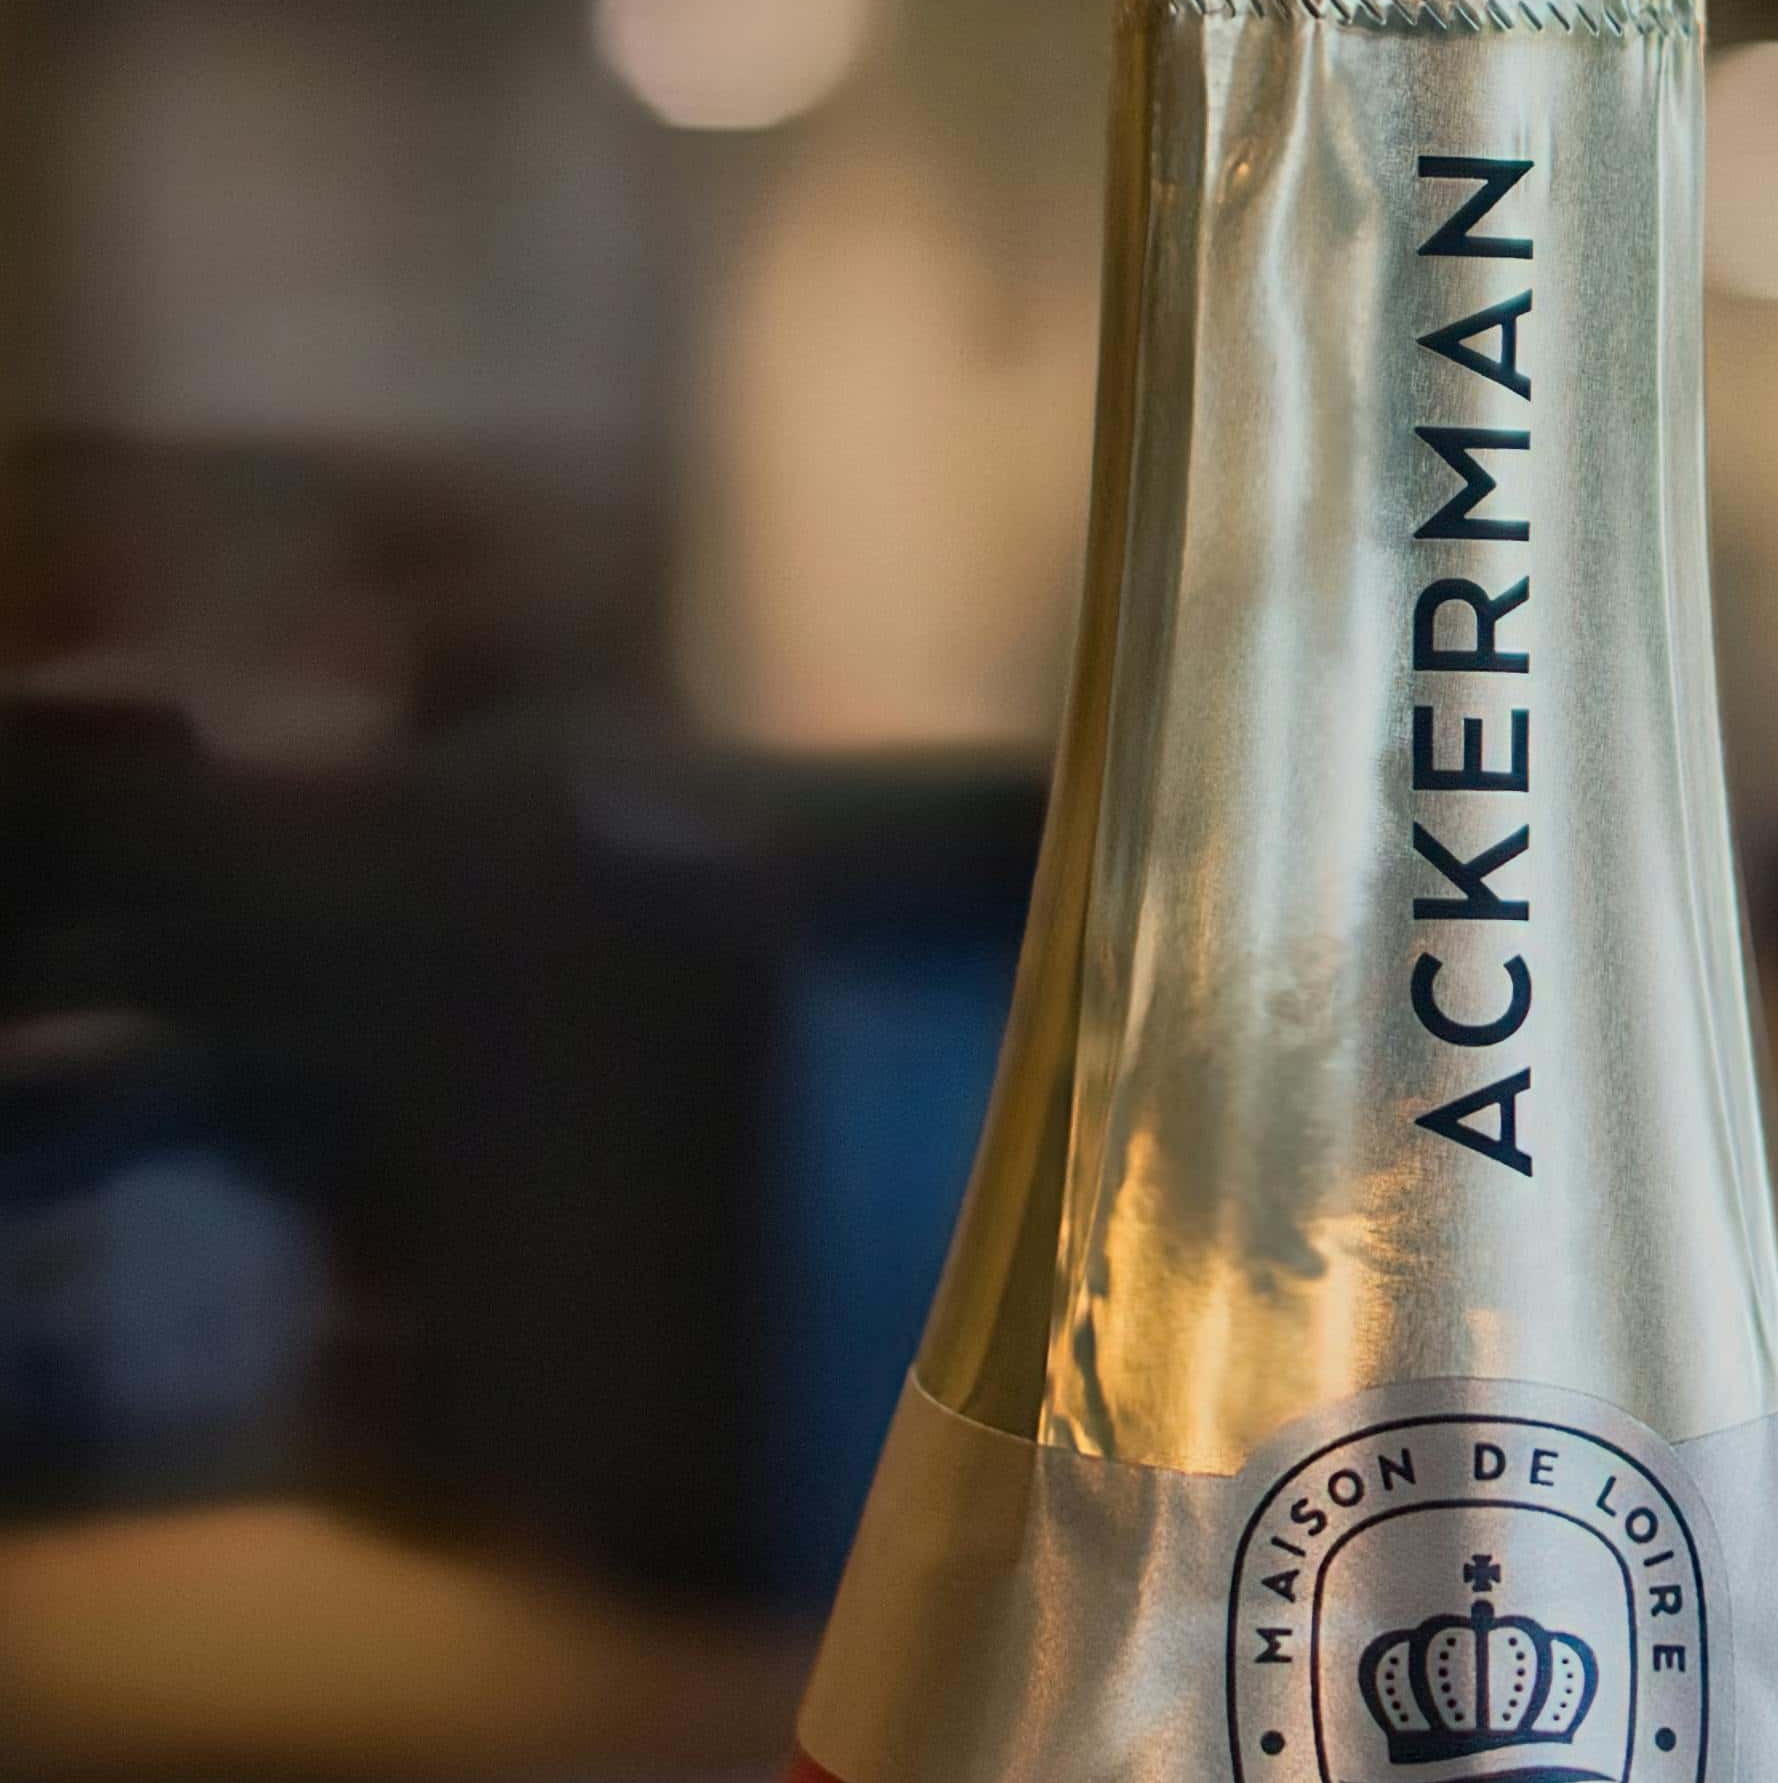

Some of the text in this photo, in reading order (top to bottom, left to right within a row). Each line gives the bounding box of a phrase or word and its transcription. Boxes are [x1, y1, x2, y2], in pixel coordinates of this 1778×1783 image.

[1410, 154, 1534, 1178] ACKERMAN
[1254, 1442, 1687, 1674] MAISON DE LOIRE
